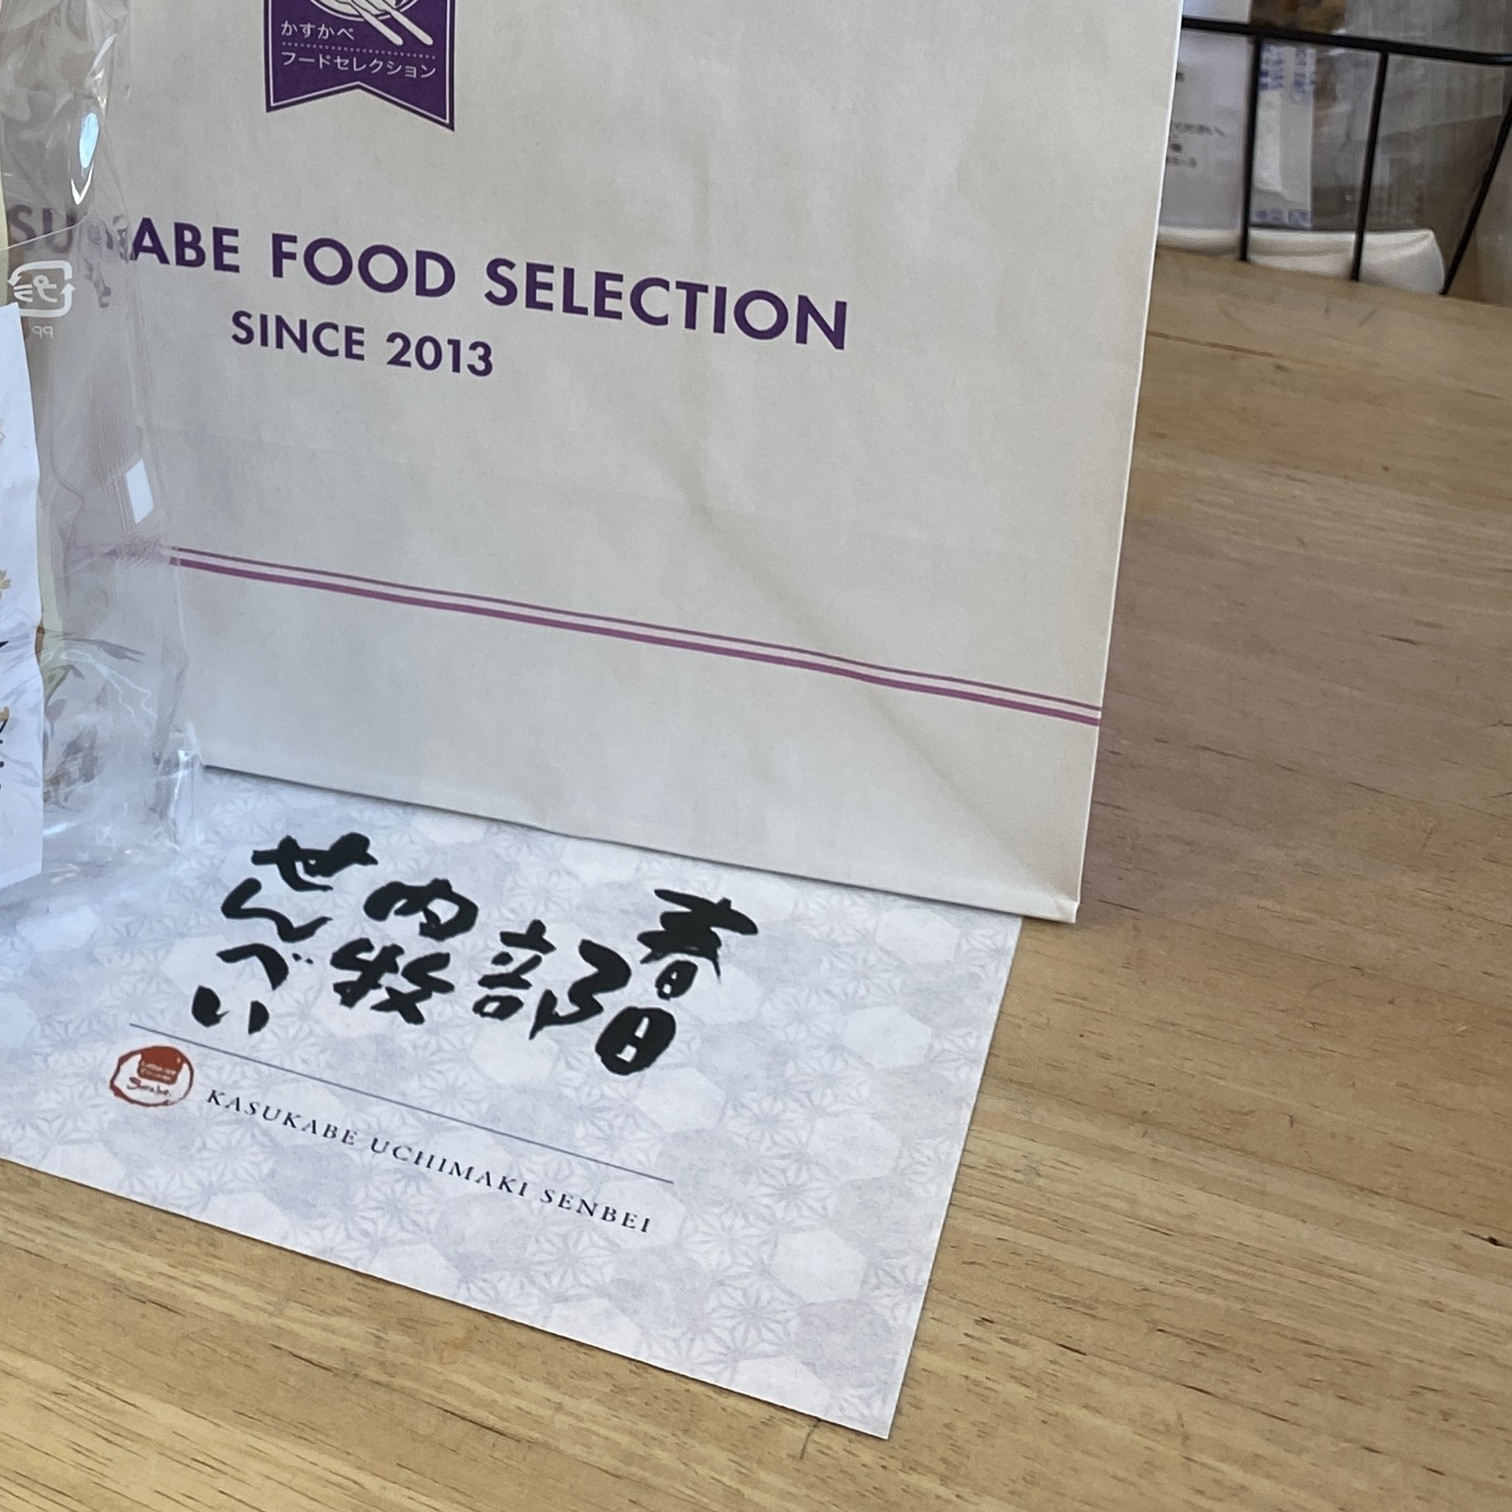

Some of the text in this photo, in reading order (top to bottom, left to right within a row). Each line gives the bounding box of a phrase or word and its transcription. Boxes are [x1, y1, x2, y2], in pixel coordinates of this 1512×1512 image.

[280, 20, 355, 41] かすかべ
[280, 51, 437, 80] フードセレクション
[271, 232, 456, 298] FOOD
[483, 257, 849, 351] SELECTION
[230, 309, 495, 378] SINCE 2013
[205, 1088, 654, 1234] KASUKABE UCHIMAKI SENBEI
